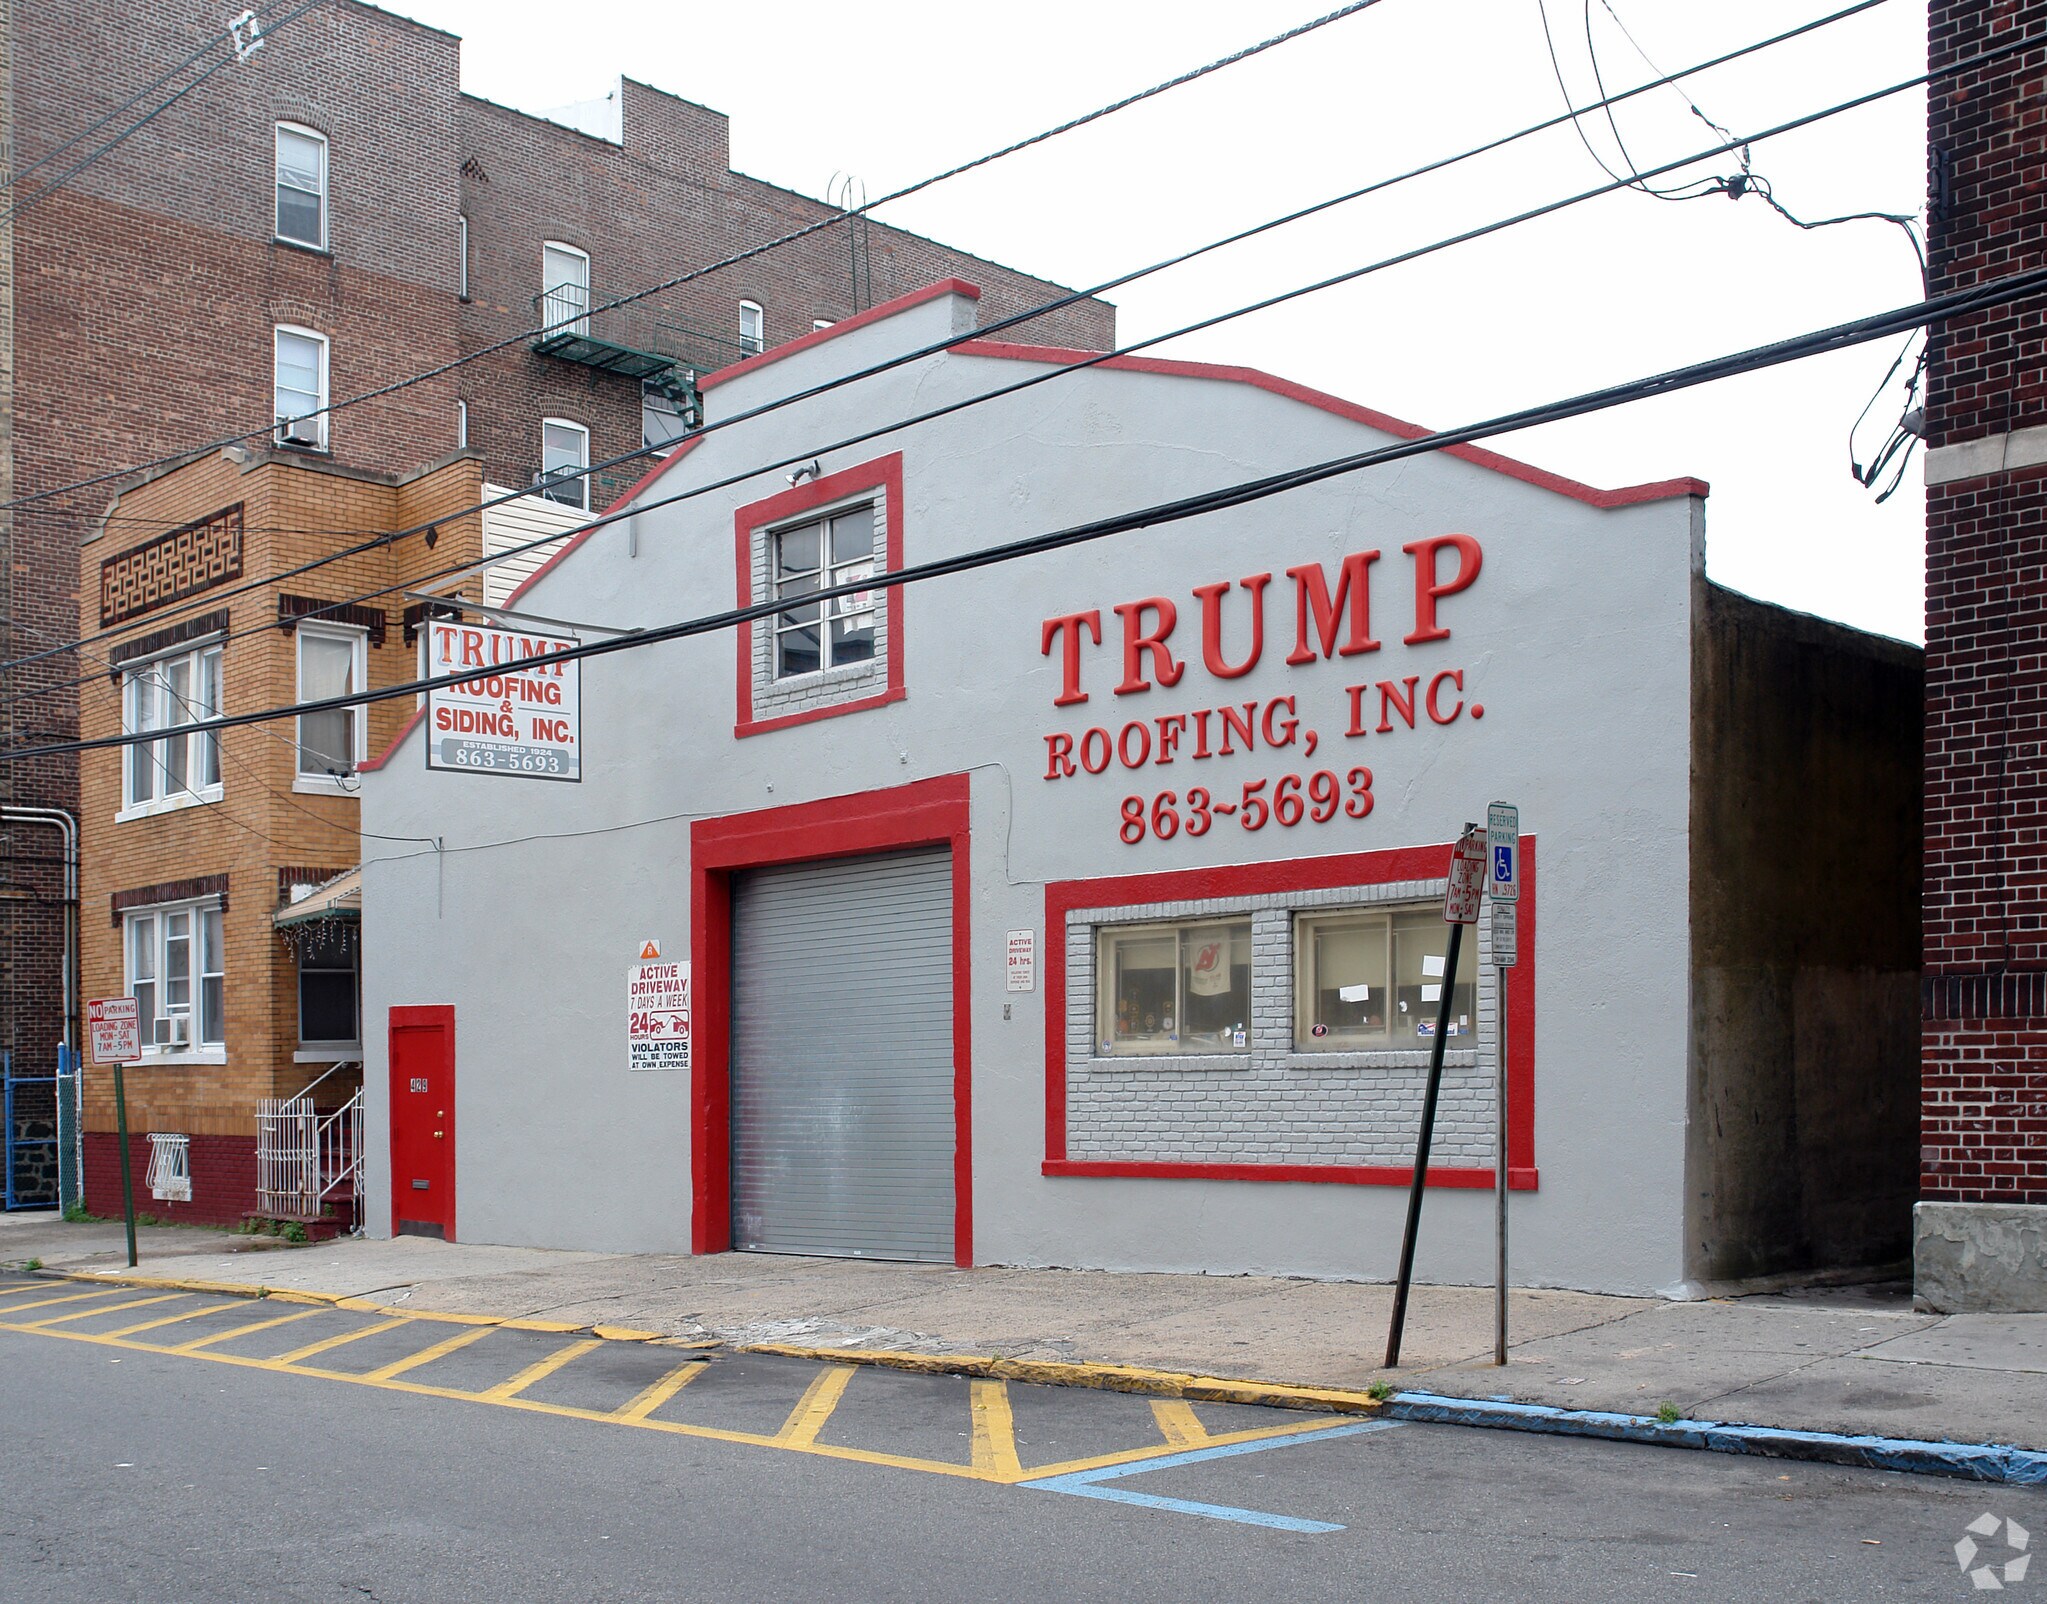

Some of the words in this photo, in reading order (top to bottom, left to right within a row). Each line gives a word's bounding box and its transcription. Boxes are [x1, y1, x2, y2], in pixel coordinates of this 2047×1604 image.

[1041, 533, 1483, 707] TRUMP
[434, 626, 572, 678] TRUMP
[500, 700, 513, 714] &
[436, 707, 519, 742] SIDING,
[533, 718, 574, 743] INC.
[1043, 694, 1319, 781] ROOFING,
[1345, 668, 1485, 738] INC.
[463, 741, 526, 754] ESTABLISHED
[530, 748, 553, 757] 1924
[456, 748, 559, 773] 863-5693
[1490, 813, 1516, 828] RESERVED
[1491, 831, 1515, 845] PARKING
[1457, 860, 1479, 873] LOADING
[1458, 872, 1473, 884] ZONE
[1009, 956, 1017, 966] 24
[1020, 956, 1032, 966] hrs.
[640, 965, 678, 980] ACTIVE
[631, 979, 688, 995] DRIVEWAY
[630, 997, 636, 1010] 7
[637, 996, 655, 1009] DAYS
[657, 996, 663, 1008] A
[666, 993, 688, 1008] WEEK
[89, 1004, 103, 1019] NO
[104, 1004, 135, 1015] PARKING
[92, 1021, 118, 1033] LOADING
[120, 1020, 136, 1030] ZONE
[630, 1012, 649, 1034] 24
[630, 1033, 649, 1041] HOURS
[631, 1041, 688, 1053] VIOLATORS
[631, 1053, 648, 1061] WILL
[651, 1052, 660, 1060] BE
[663, 1052, 689, 1060] TOWED
[632, 1061, 640, 1069] AT
[642, 1061, 657, 1069] OWN
[659, 1060, 689, 1068] EXPENSE
